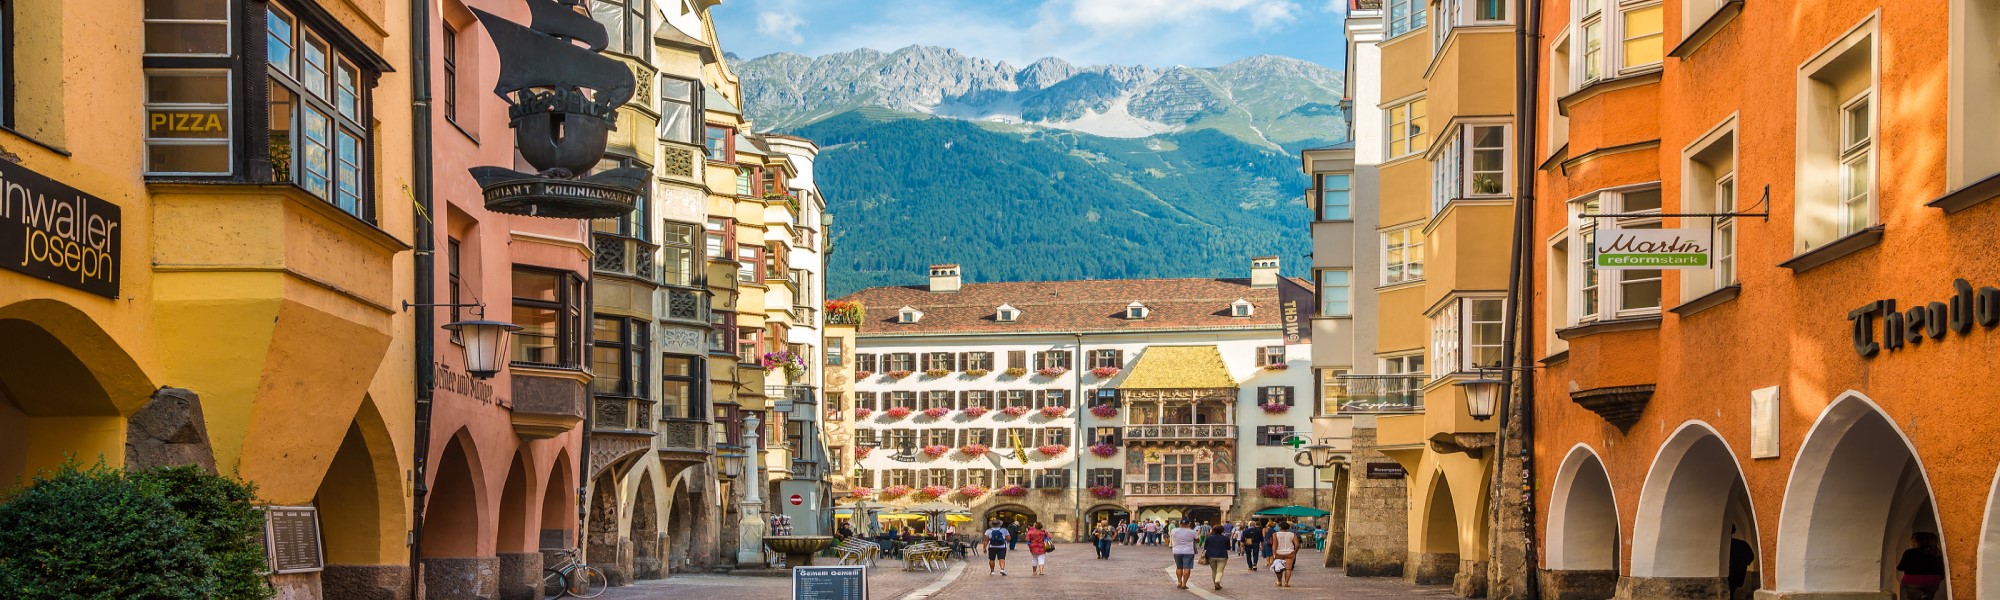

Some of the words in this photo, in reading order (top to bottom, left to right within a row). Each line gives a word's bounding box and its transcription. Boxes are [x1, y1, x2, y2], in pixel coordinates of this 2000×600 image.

[151, 113, 223, 131] PIZZA
[545, 185, 632, 203] KOLONIALWAREN
[21, 216, 112, 283] joseph
[1598, 233, 1708, 253] Martin
[1607, 255, 1698, 265] reformstark
